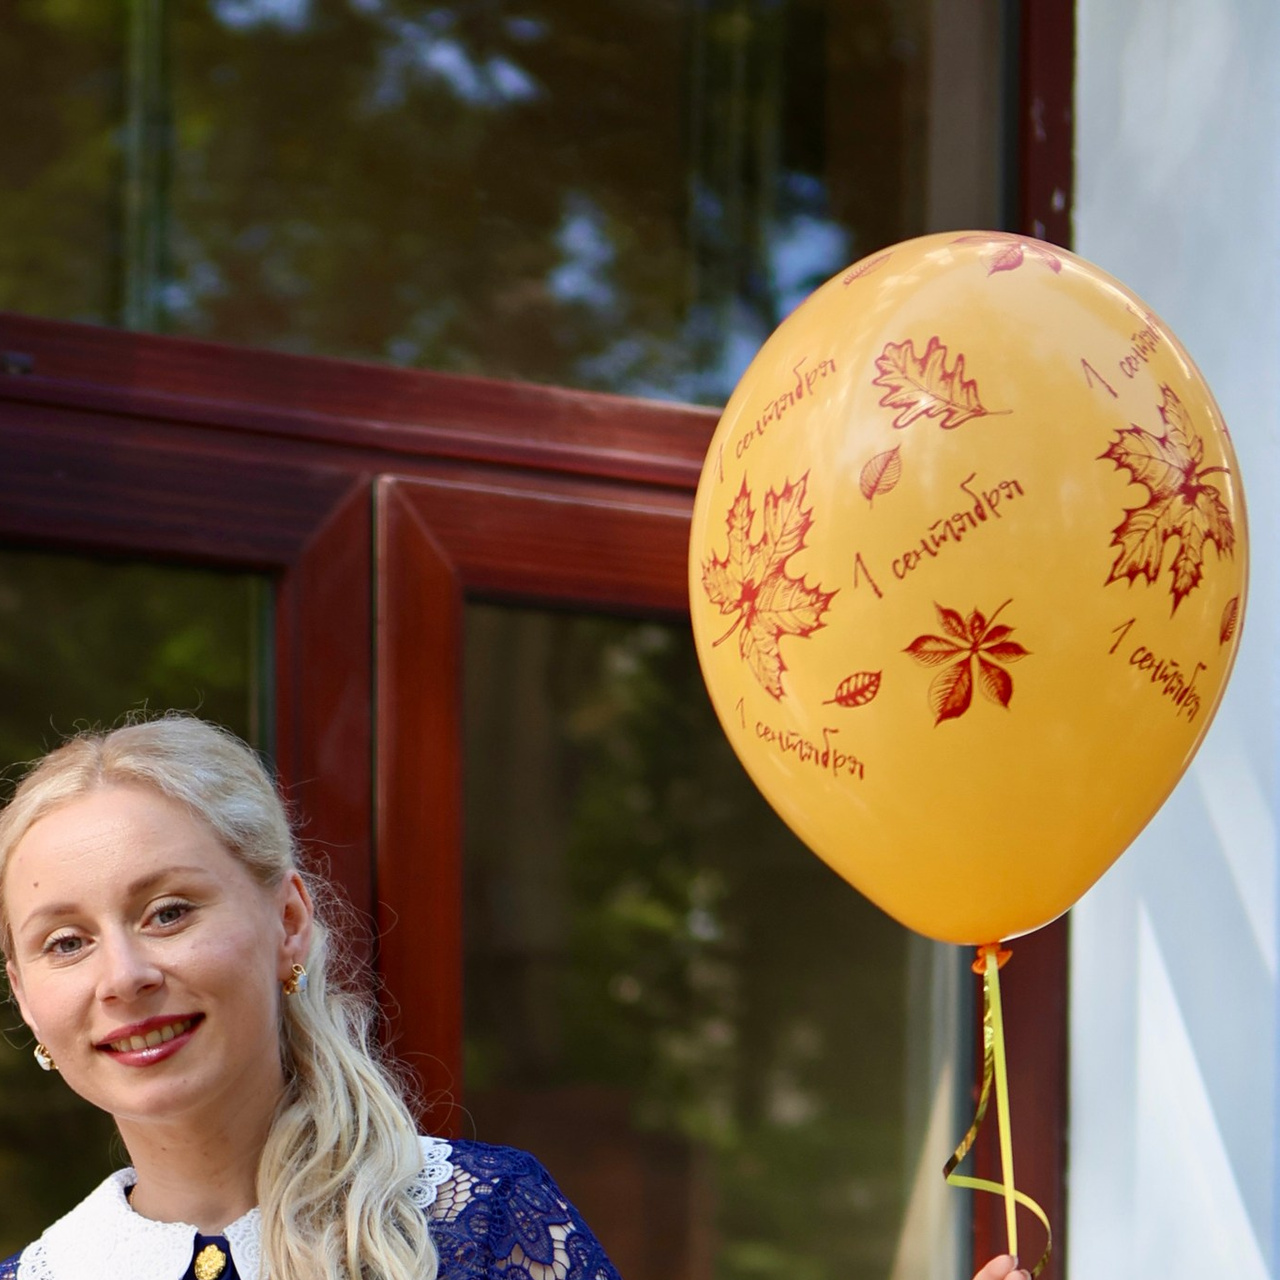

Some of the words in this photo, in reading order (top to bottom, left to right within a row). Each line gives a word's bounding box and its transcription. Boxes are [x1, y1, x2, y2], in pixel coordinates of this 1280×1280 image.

[736, 355, 836, 460] сентября
[1081, 358, 1119, 399] 1
[854, 551, 883, 599] 1
[892, 471, 1025, 580] сентября
[1108, 617, 1137, 656] 1
[735, 697, 746, 730] 1
[756, 721, 865, 781] сентября
